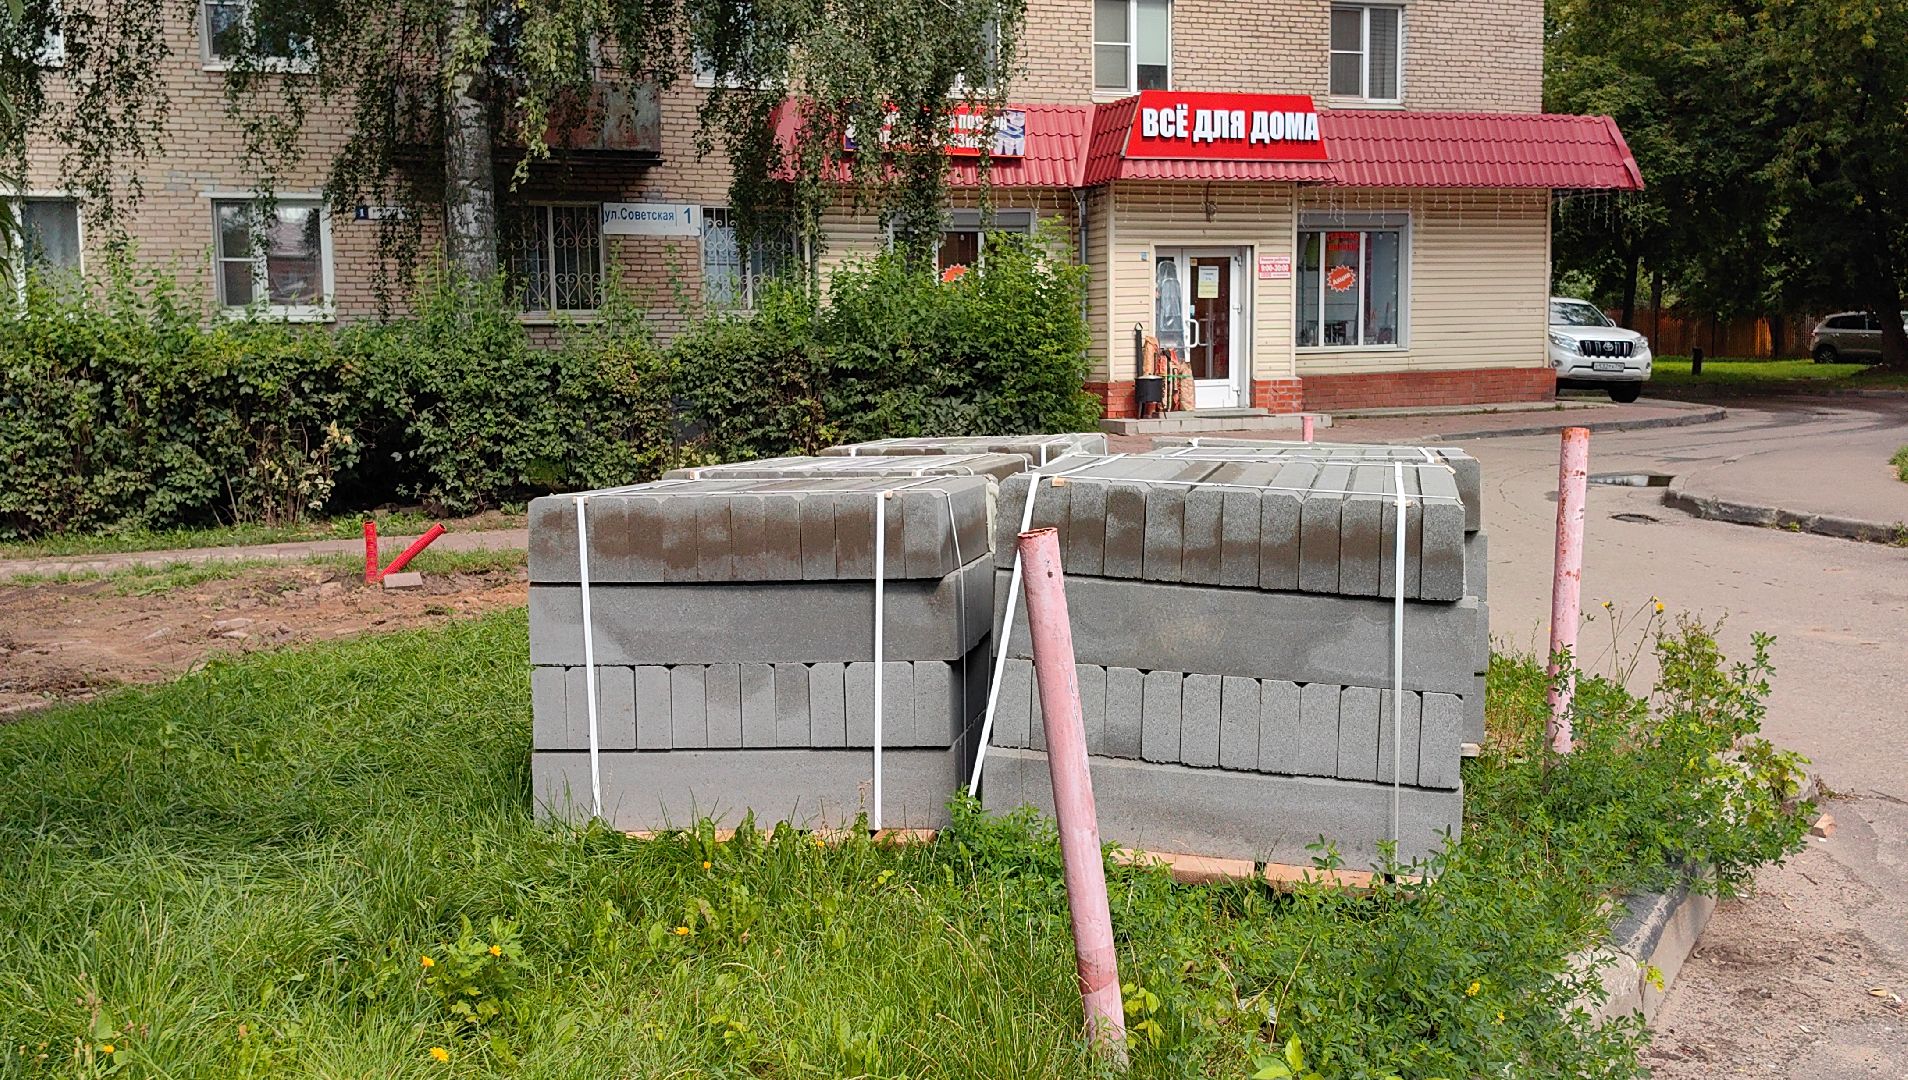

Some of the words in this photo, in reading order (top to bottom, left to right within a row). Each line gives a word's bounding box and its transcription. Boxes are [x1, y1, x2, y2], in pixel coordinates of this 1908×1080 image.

[1141, 104, 1188, 138] ВСЁ
[1193, 109, 1245, 143] ДЛЯ
[1250, 111, 1320, 144] ДОМА
[683, 207, 691, 225] 1
